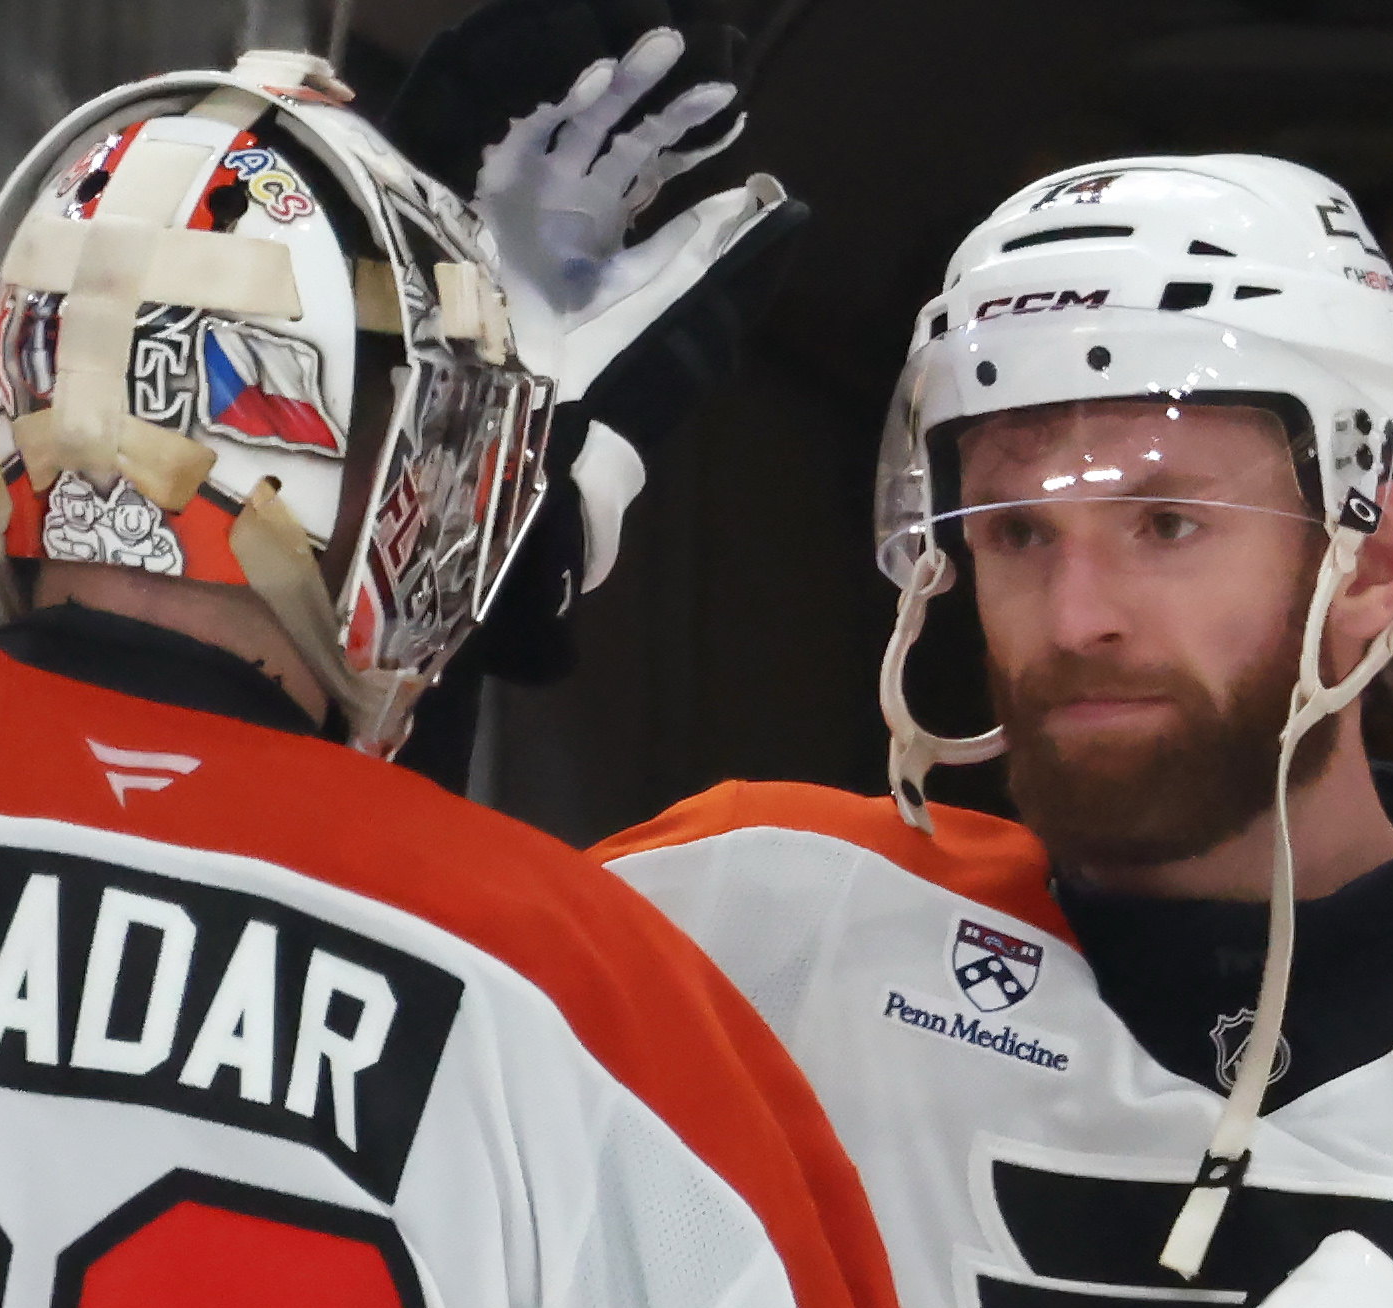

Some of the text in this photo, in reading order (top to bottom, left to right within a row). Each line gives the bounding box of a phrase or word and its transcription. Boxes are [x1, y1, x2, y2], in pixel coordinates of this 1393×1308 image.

[226, 150, 313, 221] ACS
[975, 289, 1111, 322] CCM
[883, 991, 1070, 1072] Penn Medicine
